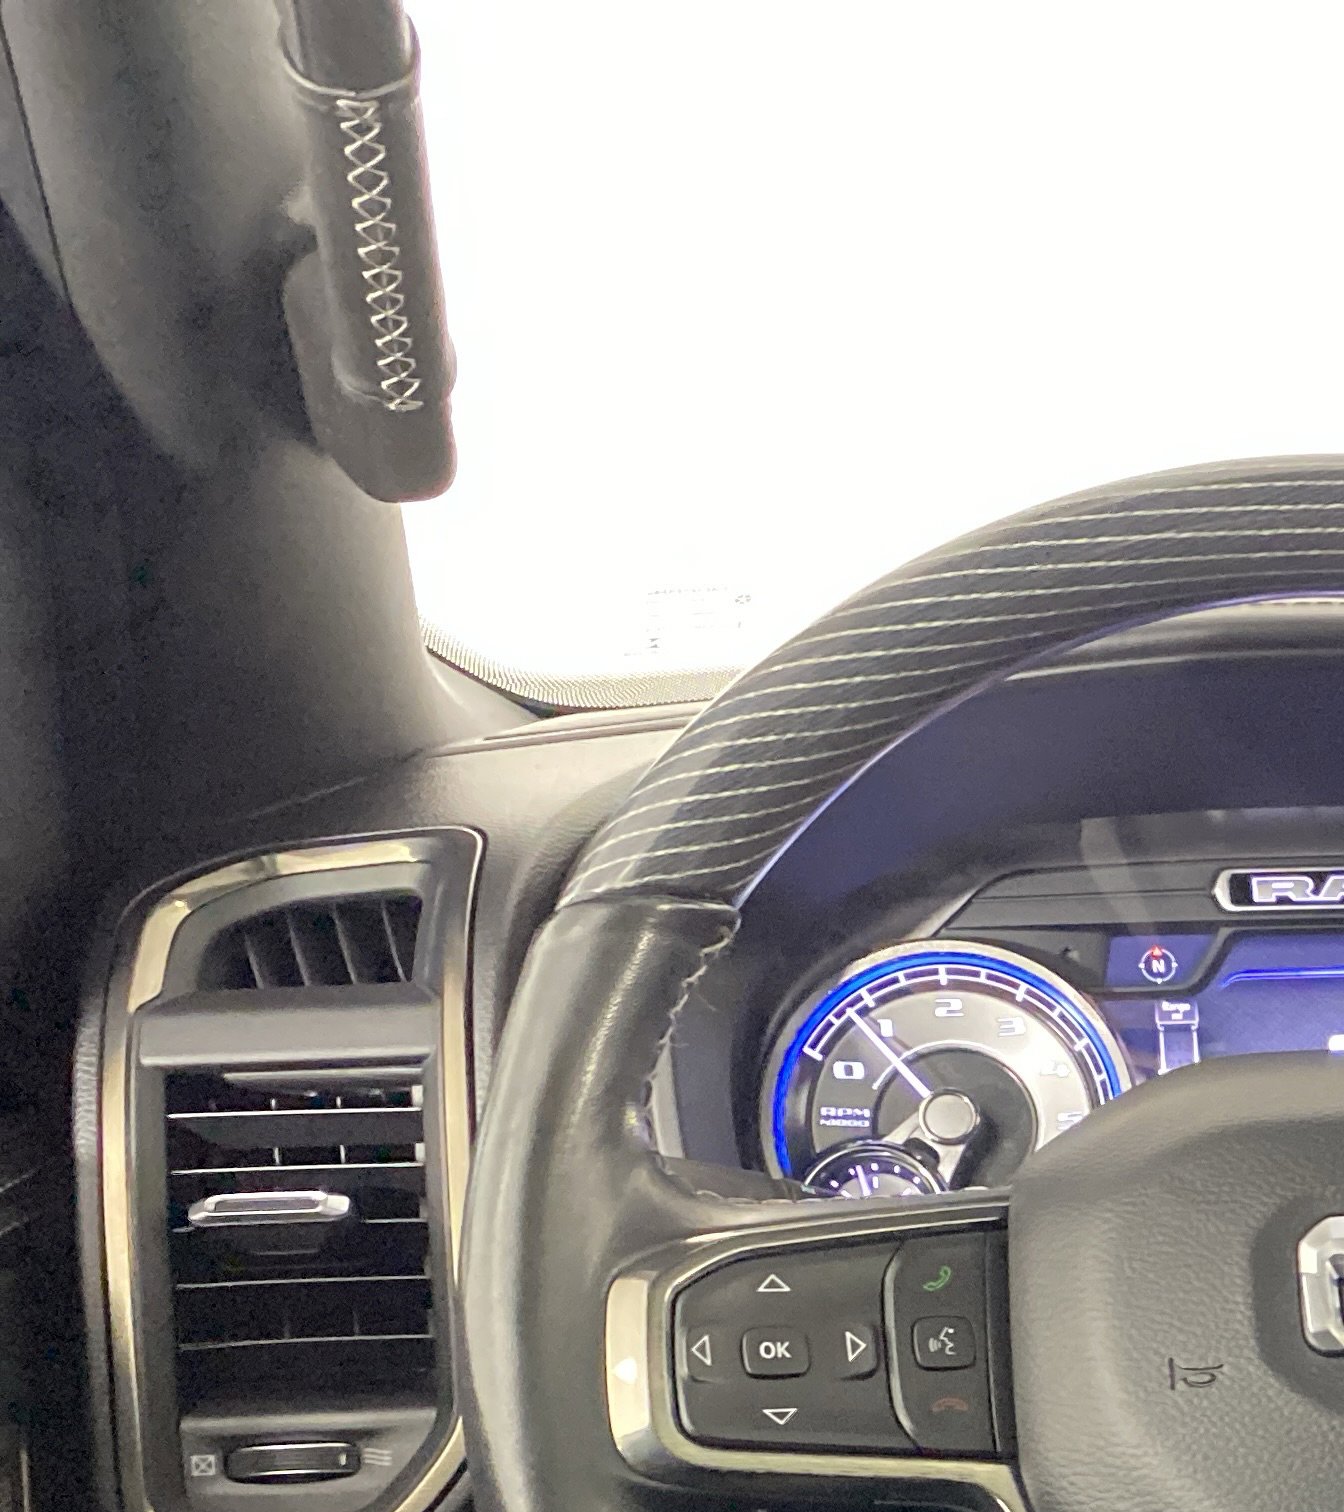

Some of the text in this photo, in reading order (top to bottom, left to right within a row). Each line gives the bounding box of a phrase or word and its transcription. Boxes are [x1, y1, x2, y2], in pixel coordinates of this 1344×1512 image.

[1153, 957, 1165, 973] N
[934, 998, 964, 1017] 2
[878, 1018, 893, 1037] 1
[997, 1017, 1026, 1036] 3
[832, 1061, 864, 1079] 0
[820, 1107, 870, 1117] RPM
[759, 1341, 792, 1359] OK
